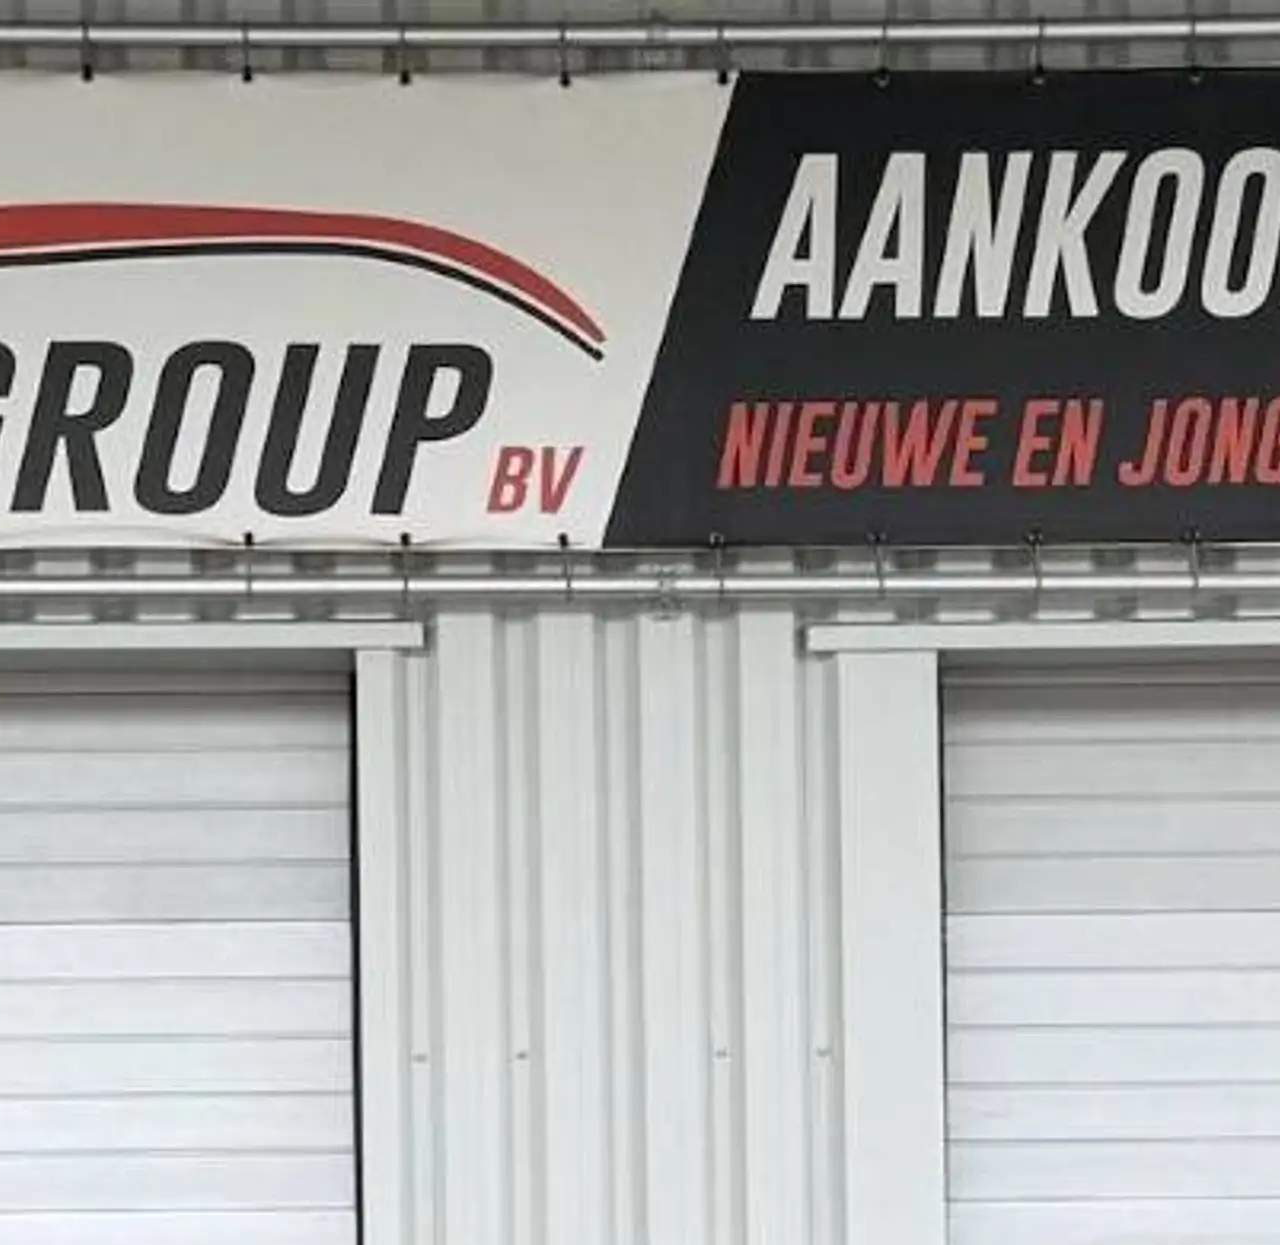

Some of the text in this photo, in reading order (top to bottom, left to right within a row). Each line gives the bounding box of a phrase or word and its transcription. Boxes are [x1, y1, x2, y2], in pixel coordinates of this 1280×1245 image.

[487, 446, 584, 514] BV
[719, 399, 993, 492] NIEUWE
[1013, 399, 1101, 486] EN
